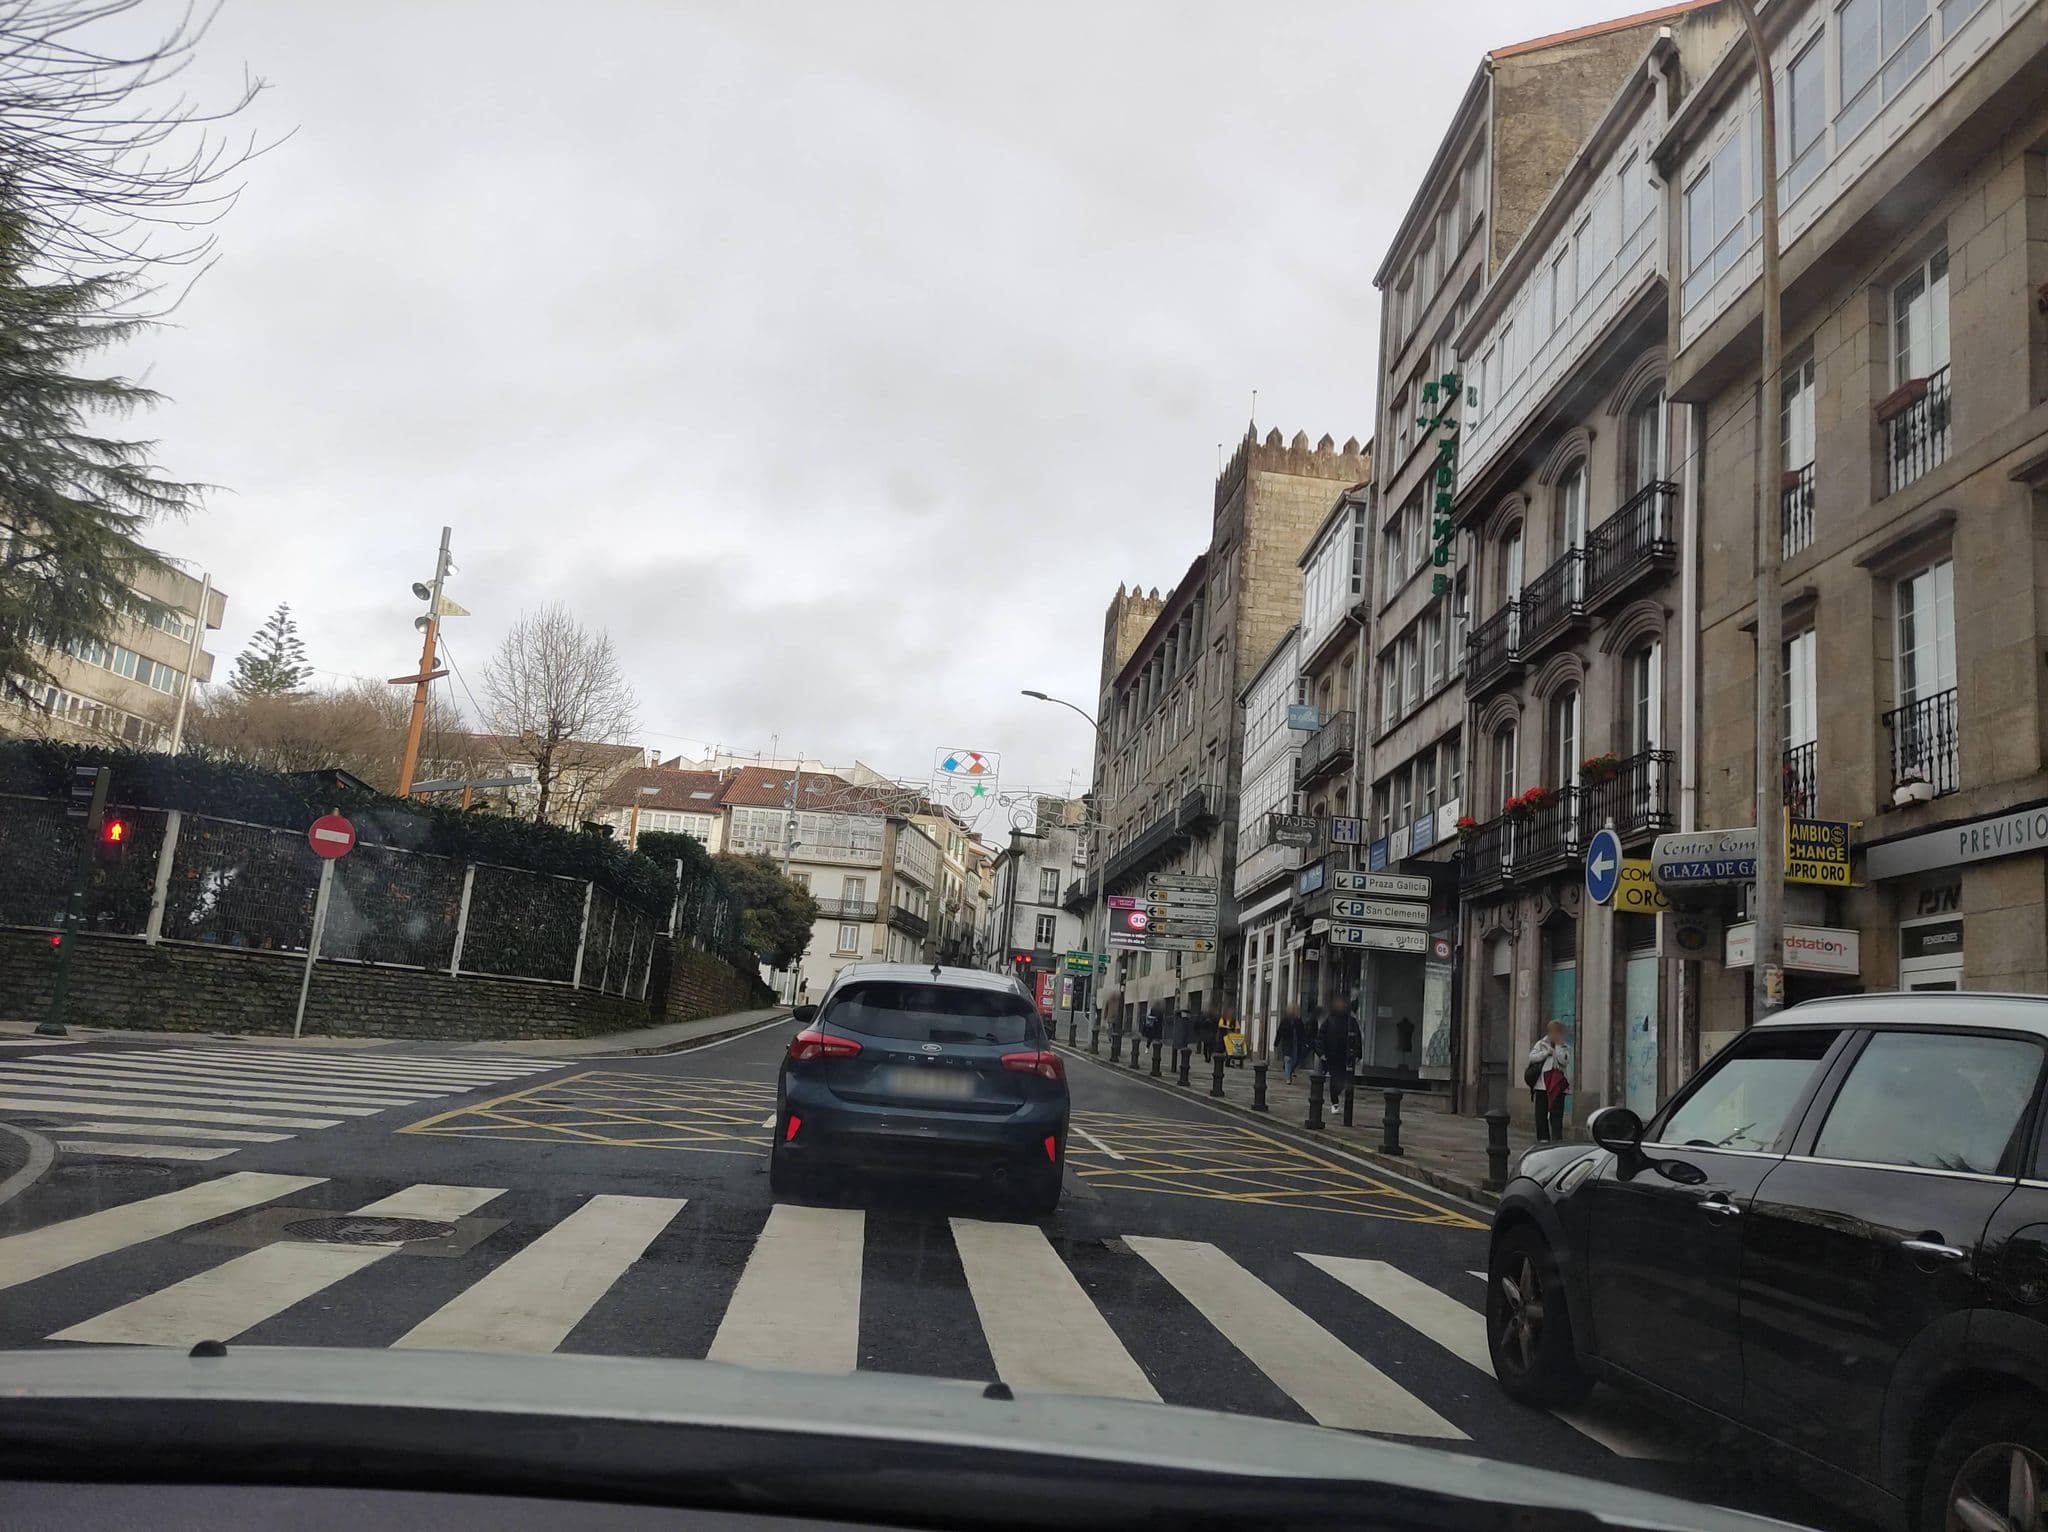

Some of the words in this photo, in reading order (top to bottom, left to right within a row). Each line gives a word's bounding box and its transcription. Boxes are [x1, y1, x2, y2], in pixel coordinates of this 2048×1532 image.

[1273, 814, 1316, 828] VIAJES
[1960, 814, 2048, 855] PREVISIO
[1663, 841, 1713, 855] Centro
[1720, 837, 1757, 852] Com
[1621, 868, 1653, 882] COM
[1664, 863, 1711, 878] PLAZA
[1716, 862, 1735, 876] DE
[1739, 861, 1758, 875] GA
[1785, 863, 1817, 879] MPRO
[1821, 865, 1845, 882] ORO
[1369, 878, 1394, 889] Praza
[1396, 880, 1427, 892] Galicia
[1366, 905, 1382, 915] San
[1384, 907, 1426, 919] Clemente
[1132, 916, 1145, 925] 30
[1396, 936, 1424, 945] outros
